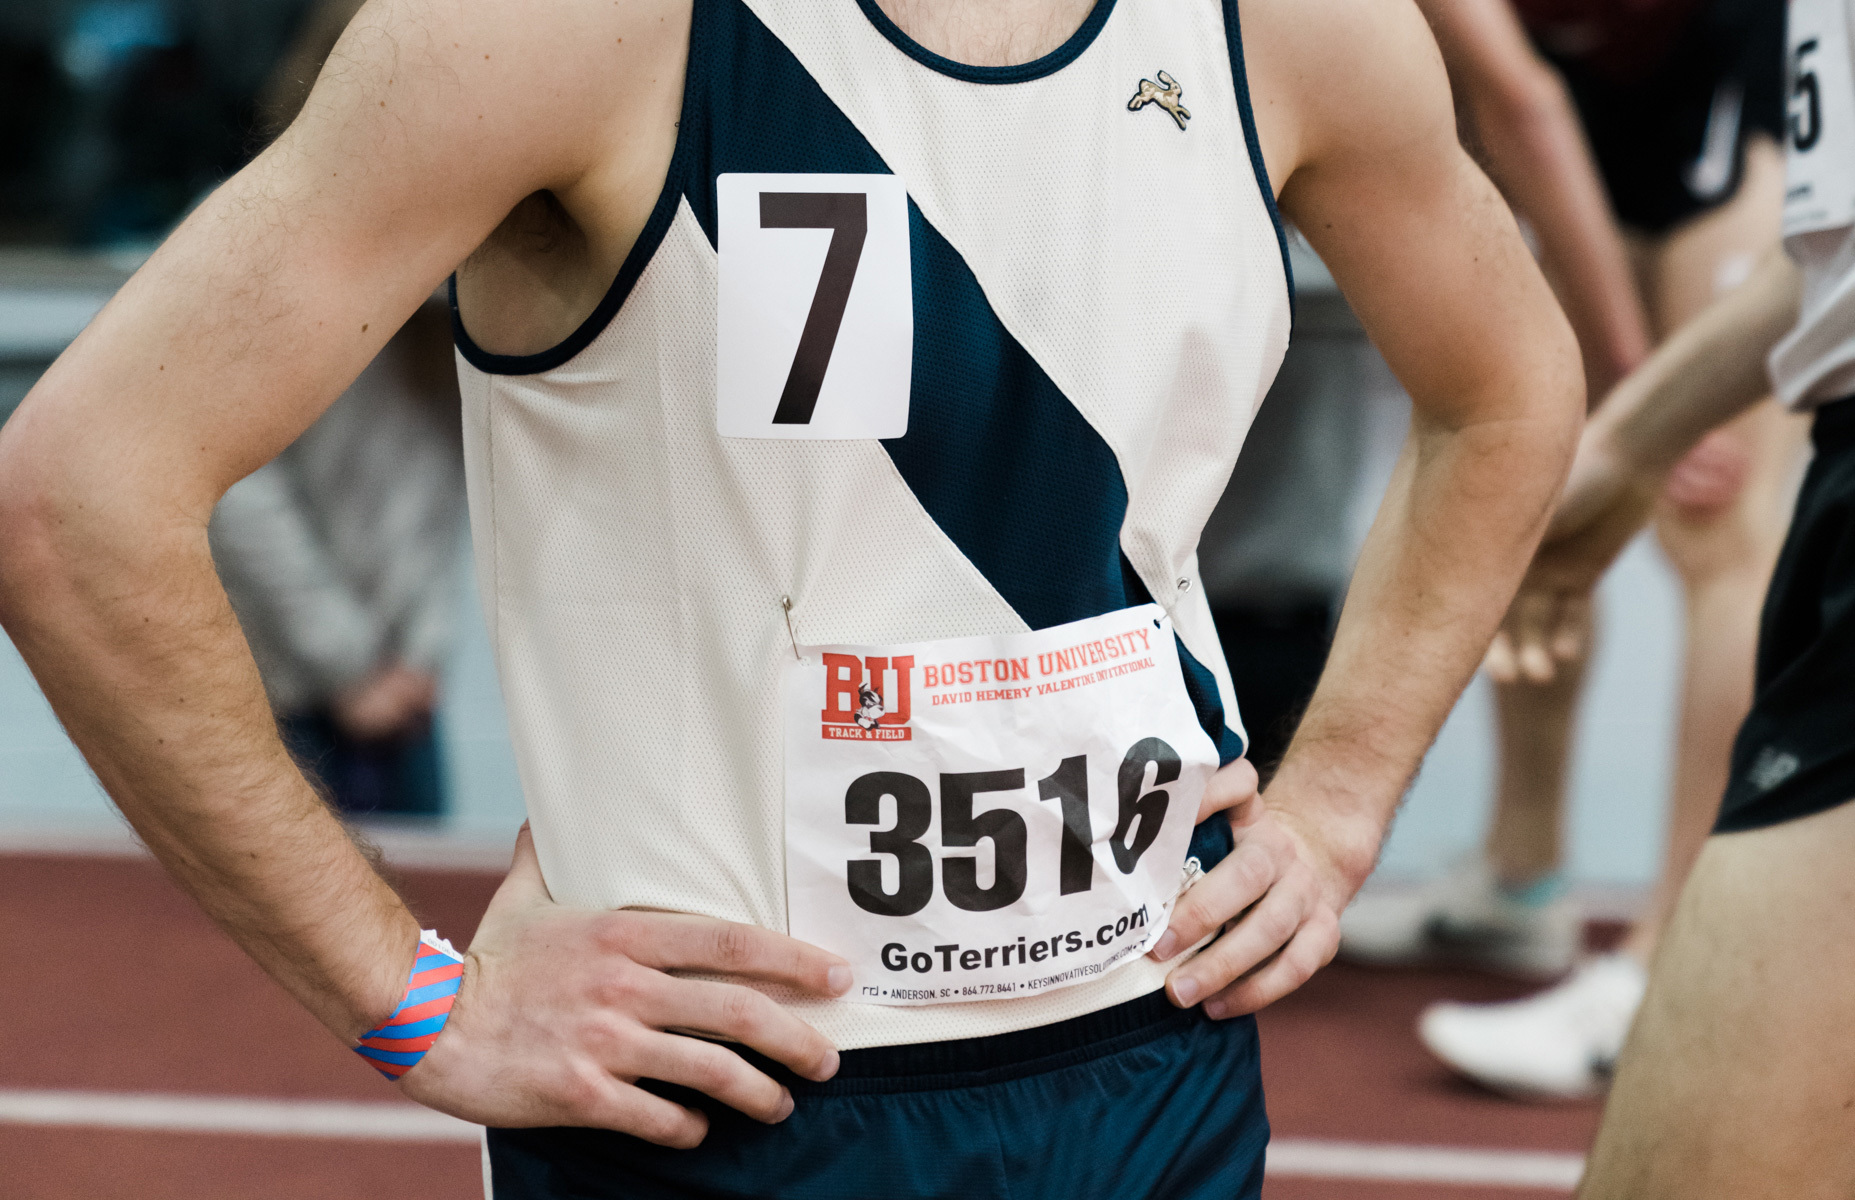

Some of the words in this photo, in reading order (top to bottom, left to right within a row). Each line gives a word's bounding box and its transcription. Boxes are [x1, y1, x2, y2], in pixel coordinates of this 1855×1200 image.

[758, 191, 868, 425] 7
[821, 652, 915, 725] BU
[923, 656, 1031, 689] BOSTON
[1037, 628, 1151, 676] UNIVERSITY
[932, 691, 972, 706] DAVID
[976, 686, 1033, 702] HEMERY
[1036, 672, 1096, 696] VALENTINE
[1096, 656, 1155, 682] INVITATIONAL
[828, 727, 863, 739] TRACK
[865, 730, 873, 740] &
[875, 729, 905, 740] FIELD
[844, 736, 1182, 917] 3516
[880, 902, 1150, 974] GoTerriers.com
[940, 988, 951, 998] SC
[962, 982, 1016, 996] 864.772.8441
